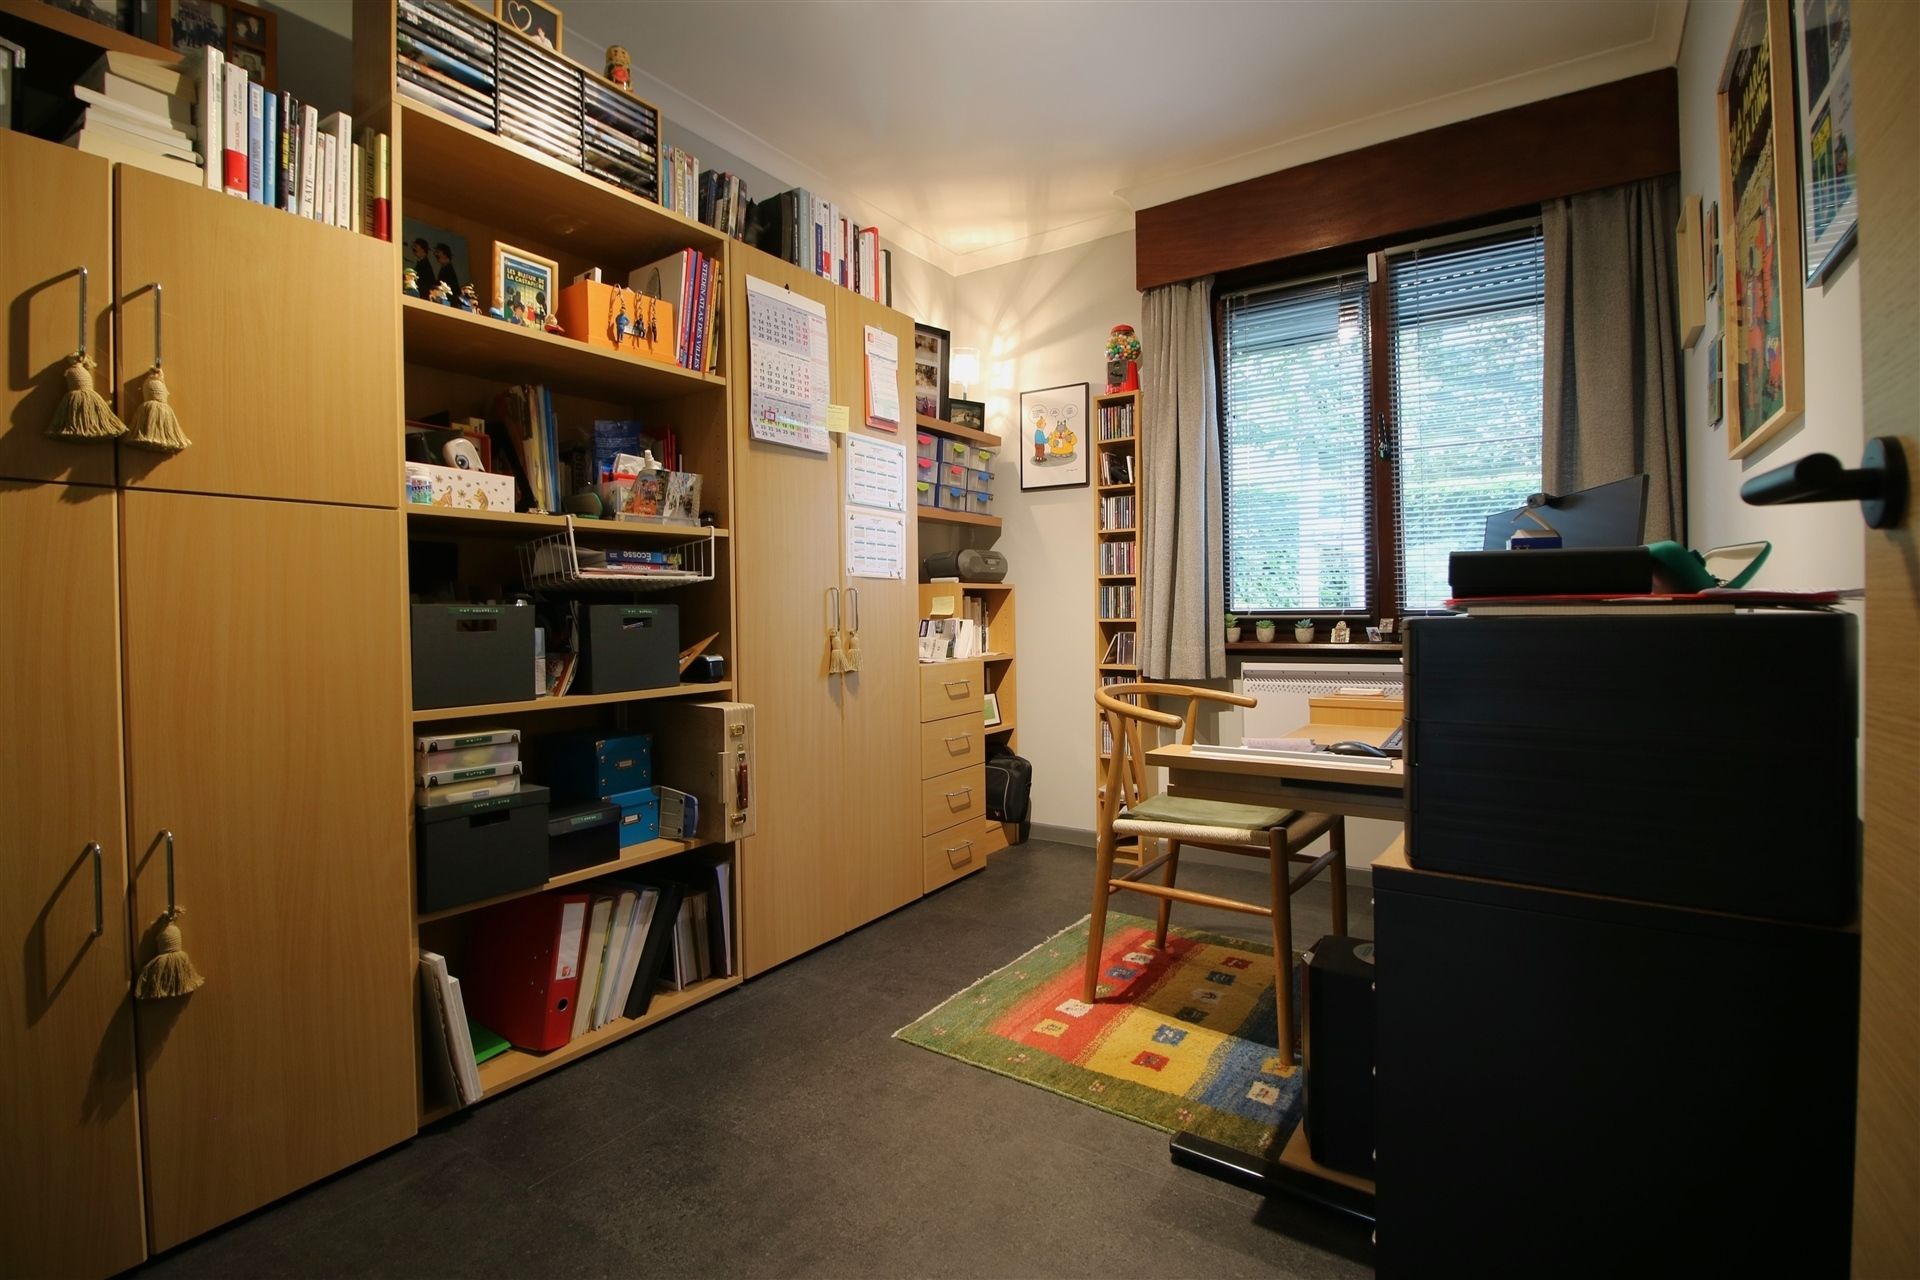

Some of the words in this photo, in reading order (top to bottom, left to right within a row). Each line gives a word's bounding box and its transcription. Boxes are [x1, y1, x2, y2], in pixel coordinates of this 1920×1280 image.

[304, 177, 313, 204] KATE
[507, 267, 516, 275] LES
[699, 263, 708, 295] STEDEN
[697, 296, 706, 321] ATLAS
[694, 340, 702, 368] VILLES
[623, 551, 651, 562] Écosse
